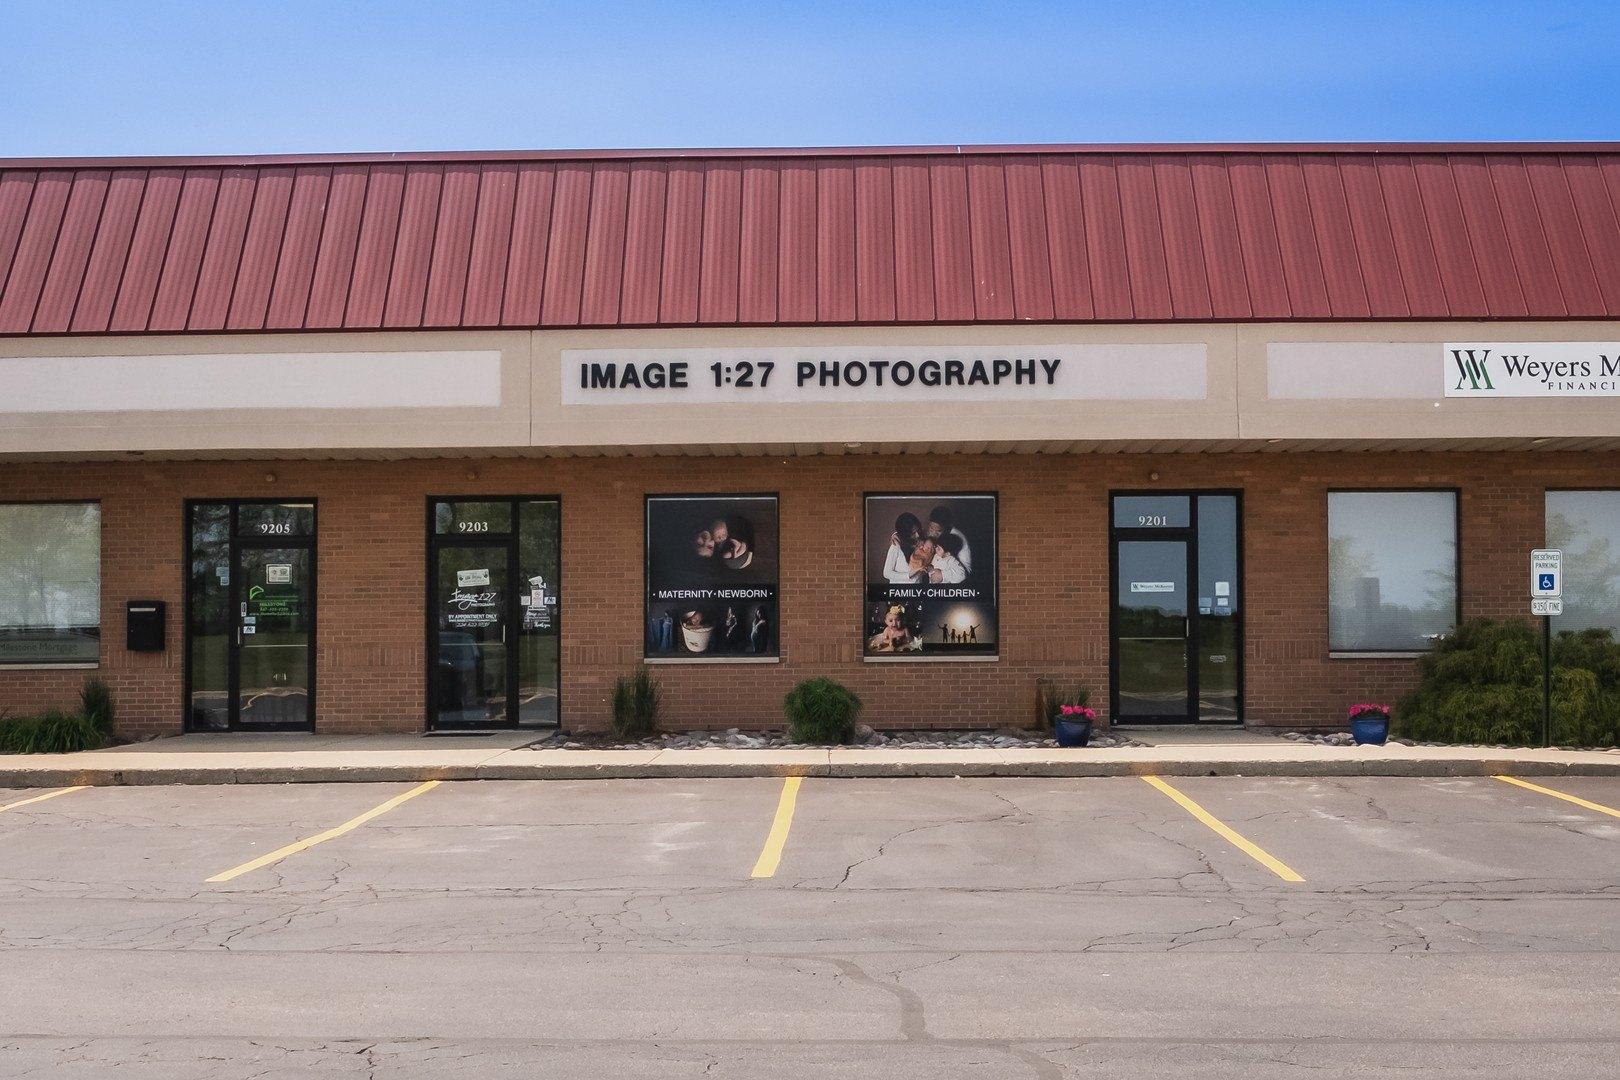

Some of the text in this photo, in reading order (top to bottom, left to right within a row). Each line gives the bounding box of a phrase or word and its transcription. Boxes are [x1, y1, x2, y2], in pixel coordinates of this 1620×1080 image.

[581, 359, 1062, 389] IMAGE 1:27 PHOTOGRAPHY
[1501, 355, 1591, 384] Weyers
[1548, 381, 1616, 391] FINANCI
[1138, 515, 1167, 526] 9201
[261, 523, 291, 534] 9205
[459, 521, 488, 532] 9203
[658, 589, 768, 599] MATERNITY NEWBORN
[888, 588, 976, 598] FAMILY CHILDREN
